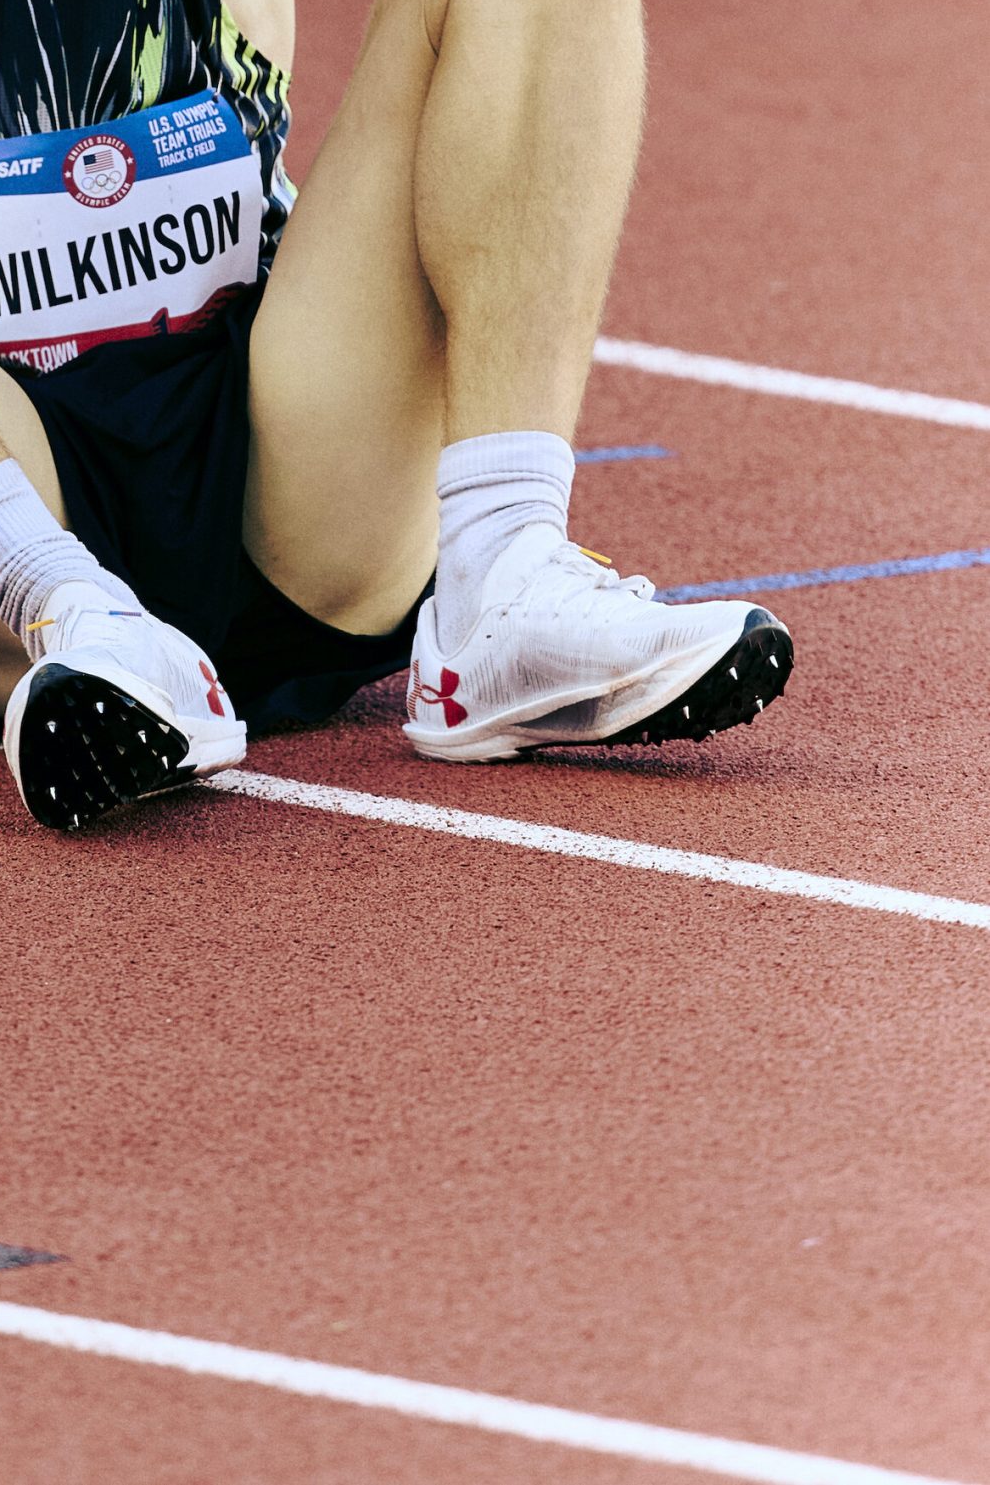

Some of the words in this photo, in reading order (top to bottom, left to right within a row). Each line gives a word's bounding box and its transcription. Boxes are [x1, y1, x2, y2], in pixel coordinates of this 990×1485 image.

[148, 116, 174, 136] U.S.
[172, 100, 219, 128] OLYMPIC
[68, 138, 94, 161] UNITED
[96, 136, 126, 151] STATES
[152, 129, 188, 155] TEAM
[187, 116, 227, 143] TRIALS
[157, 149, 187, 168] TRACK
[186, 147, 195, 159] &
[193, 139, 216, 156] FIELD
[75, 191, 111, 207] OLYMPIC
[113, 182, 132, 202] TEAM
